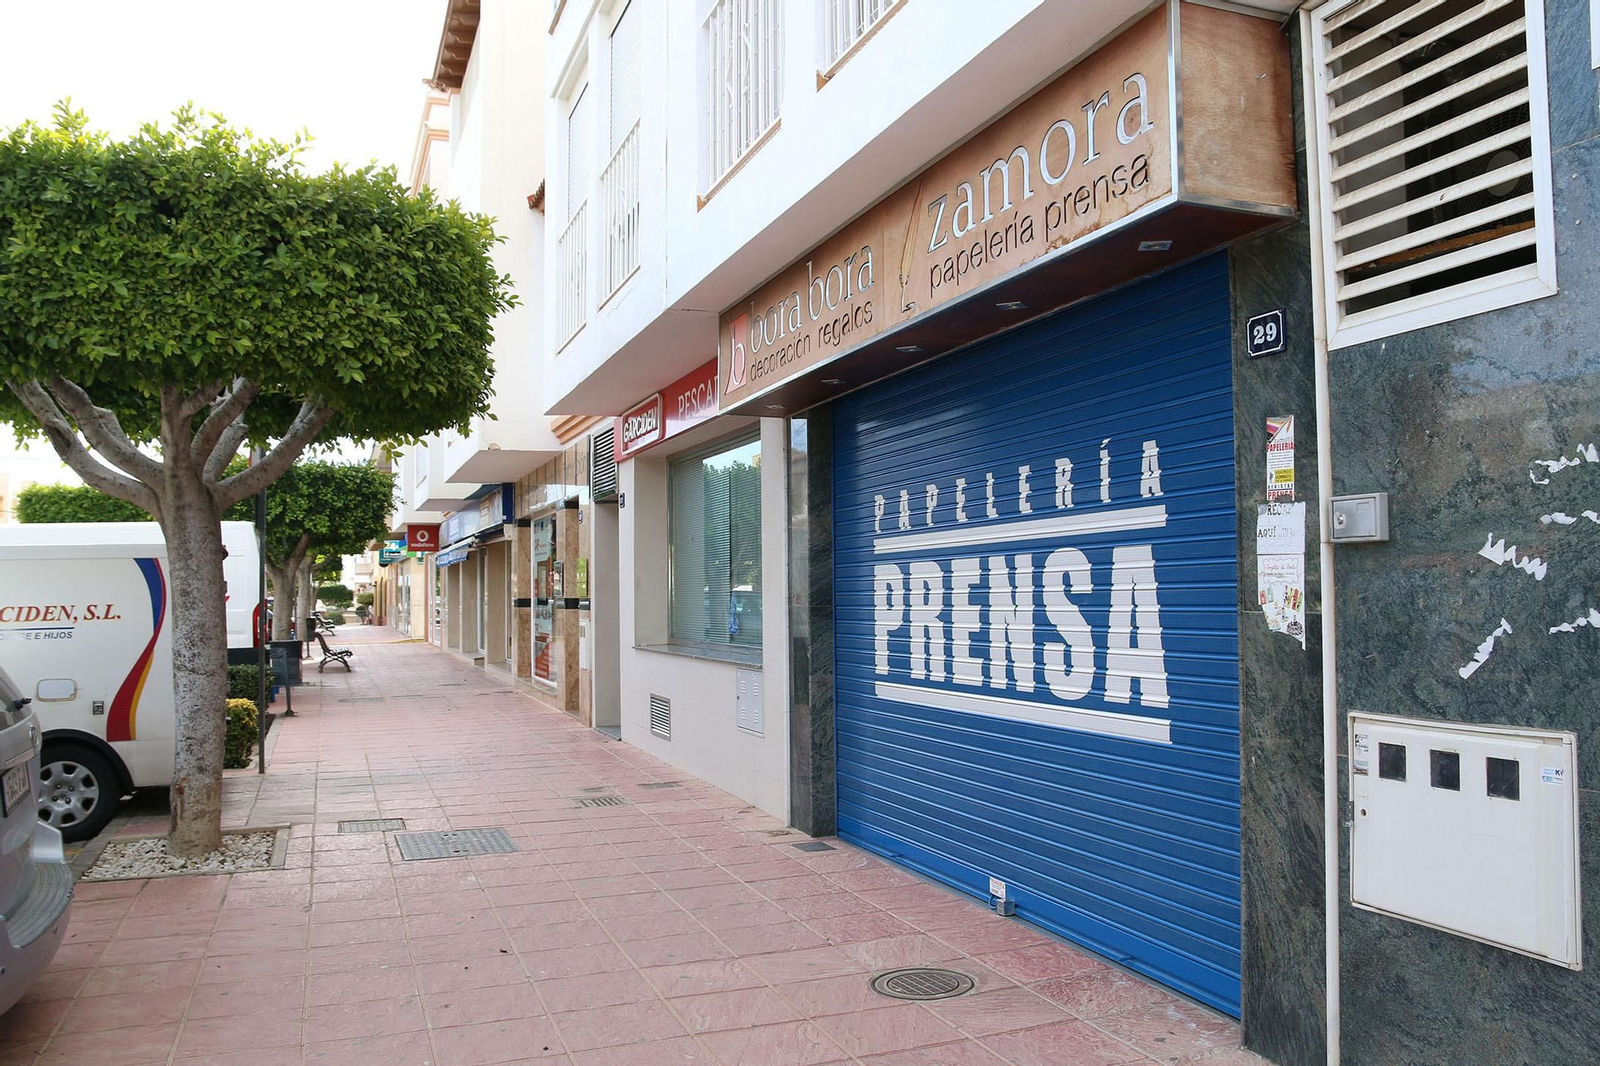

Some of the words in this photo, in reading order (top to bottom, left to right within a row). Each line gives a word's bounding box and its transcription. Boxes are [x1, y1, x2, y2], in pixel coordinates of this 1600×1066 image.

[928, 73, 1153, 254] zamora
[930, 211, 1035, 298] papelería
[1045, 153, 1150, 242] prensa
[749, 331, 811, 382] decoración
[818, 300, 874, 347] regalos
[750, 290, 802, 355] bora
[806, 245, 875, 321] bora
[1253, 321, 1278, 346] 29
[873, 437, 1164, 533] PAPELERÍA
[44, 631, 73, 640] HIJOS
[83, 604, 122, 620] S.L.
[874, 544, 1171, 709] PRENSA
